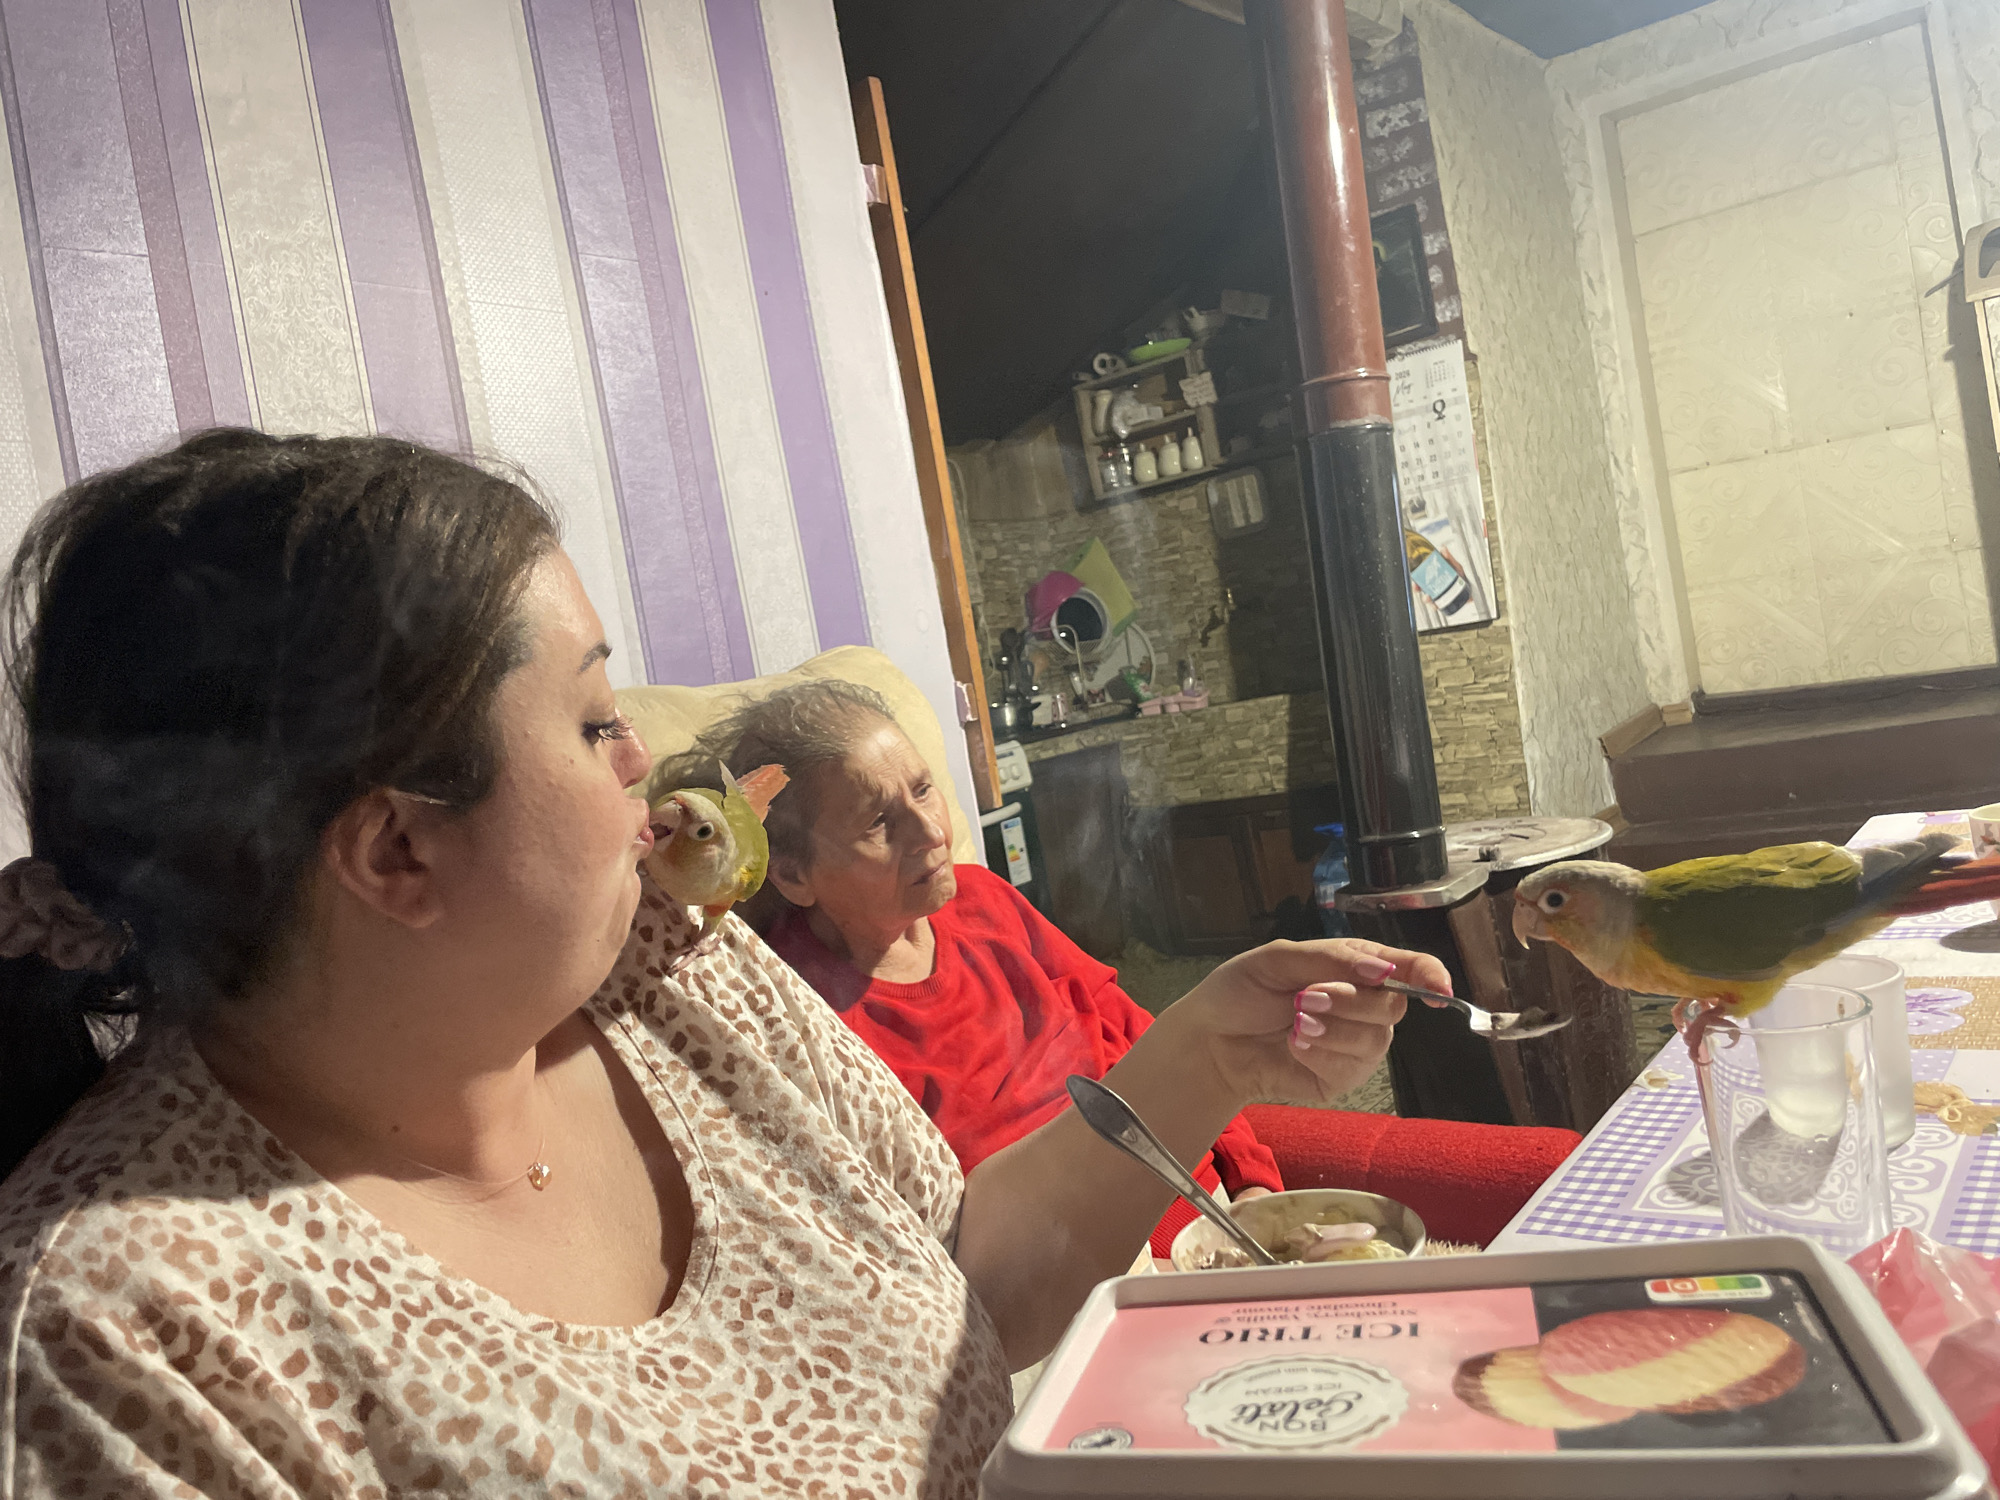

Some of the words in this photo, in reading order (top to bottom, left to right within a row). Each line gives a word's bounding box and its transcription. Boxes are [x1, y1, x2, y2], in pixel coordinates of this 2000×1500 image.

[1430, 454, 1437, 463] 22
[1232, 1304, 1300, 1314] Flavour
[1306, 1301, 1398, 1311] Chocolate
[1214, 1316, 1232, 1325] &
[1236, 1313, 1300, 1323] Vanilla
[1199, 1326, 1322, 1344] TRIO
[1335, 1321, 1419, 1341] ICE
[1245, 1384, 1308, 1396] CREAM
[1313, 1382, 1342, 1391] ICE
[1231, 1391, 1362, 1424] Gelati
[1259, 1419, 1327, 1432] BON
